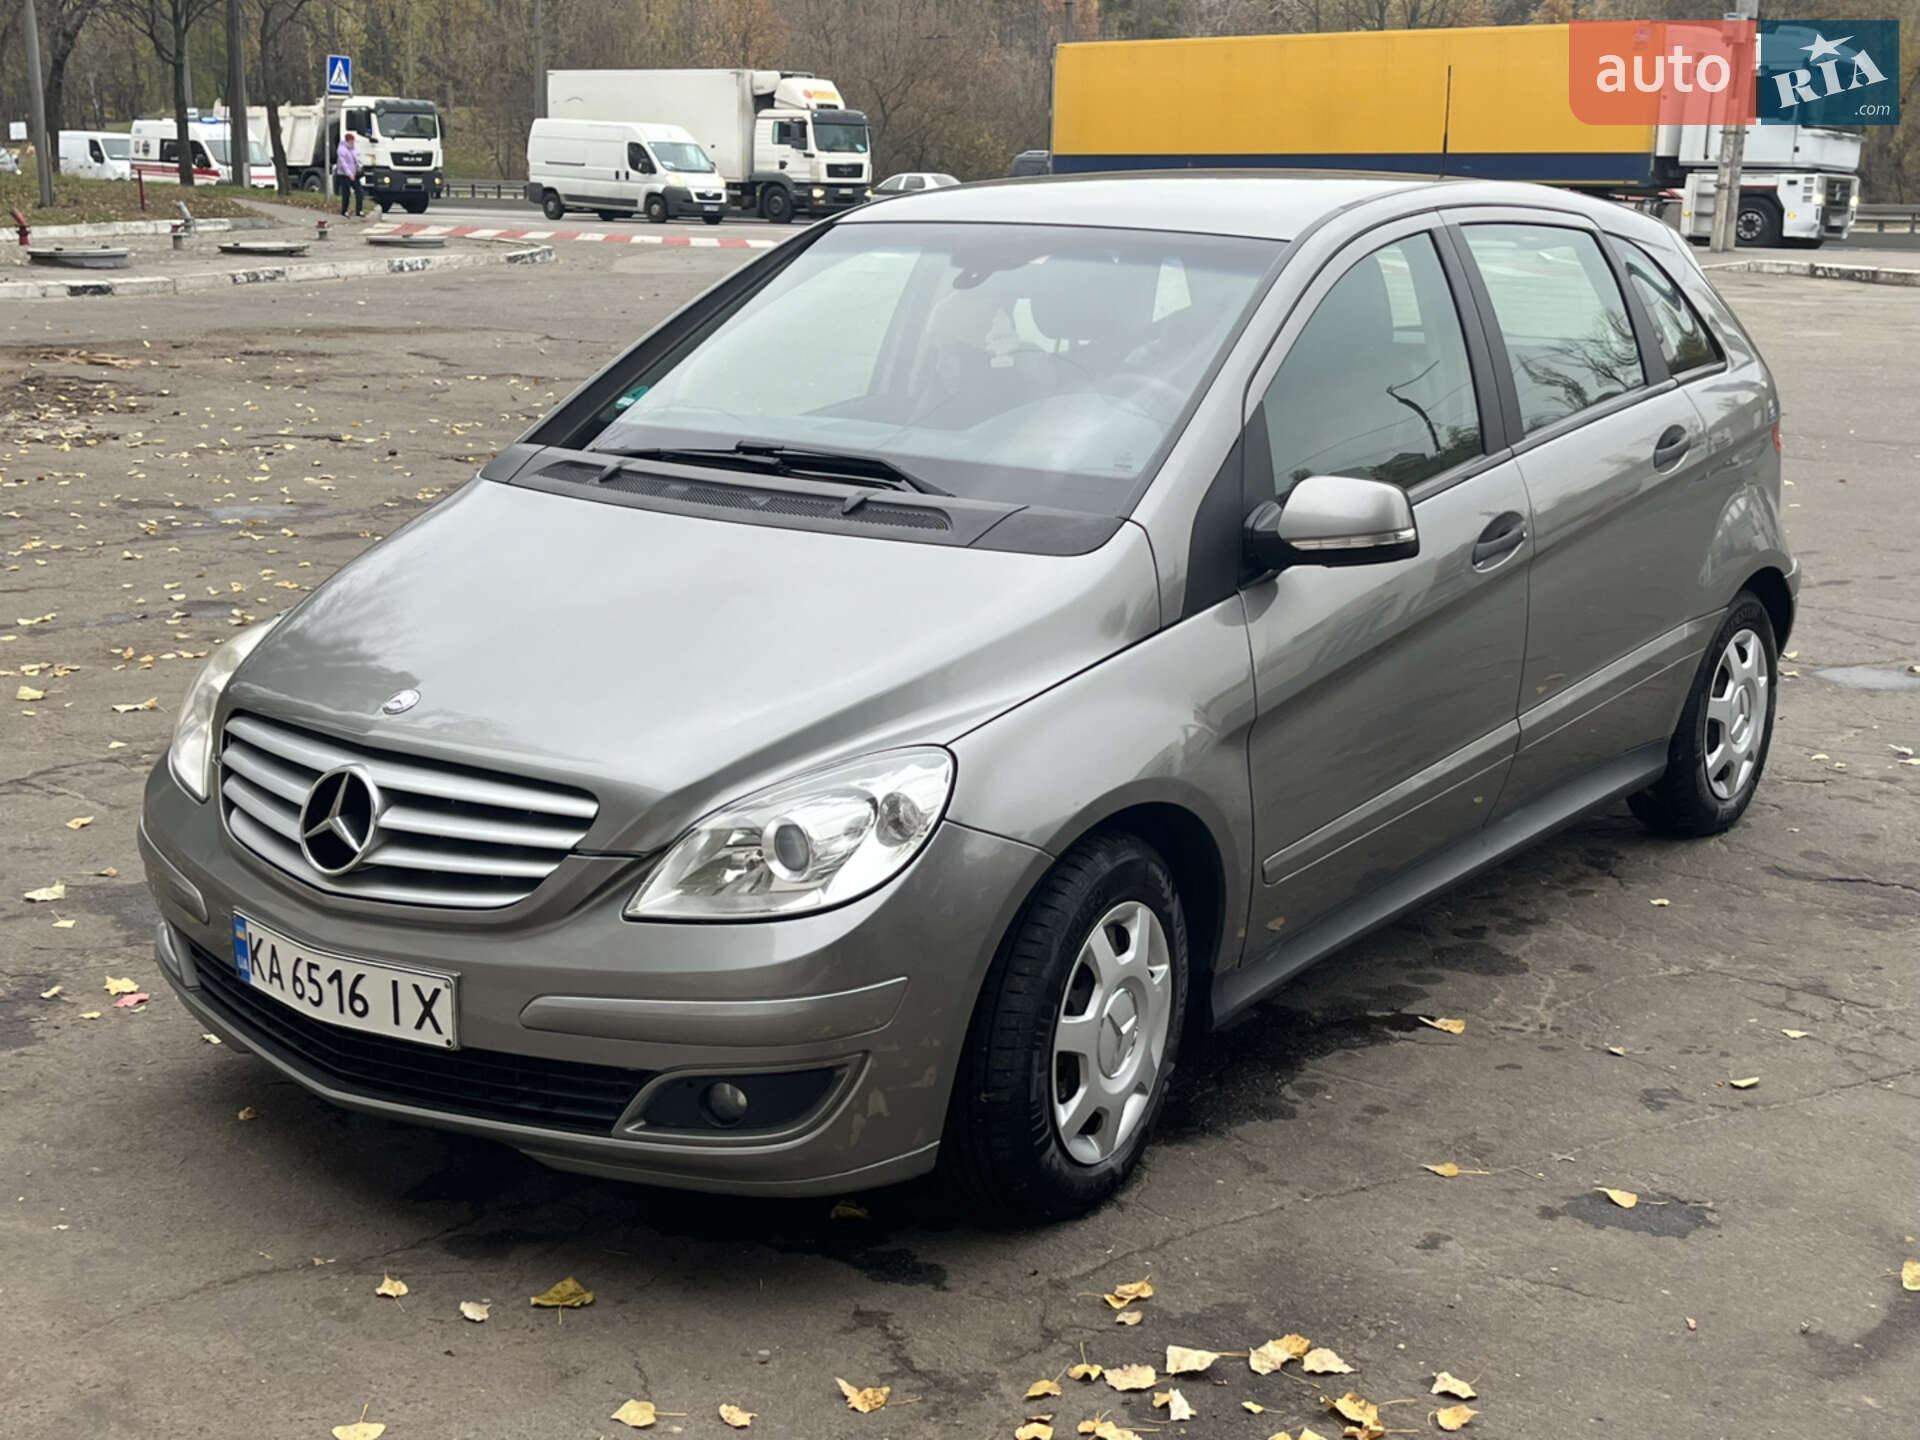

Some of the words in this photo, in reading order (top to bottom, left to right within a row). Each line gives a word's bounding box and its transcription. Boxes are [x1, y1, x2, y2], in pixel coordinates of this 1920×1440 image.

[248, 931, 285, 991] KA
[292, 957, 370, 1018] 6516
[391, 979, 443, 1035] IX
